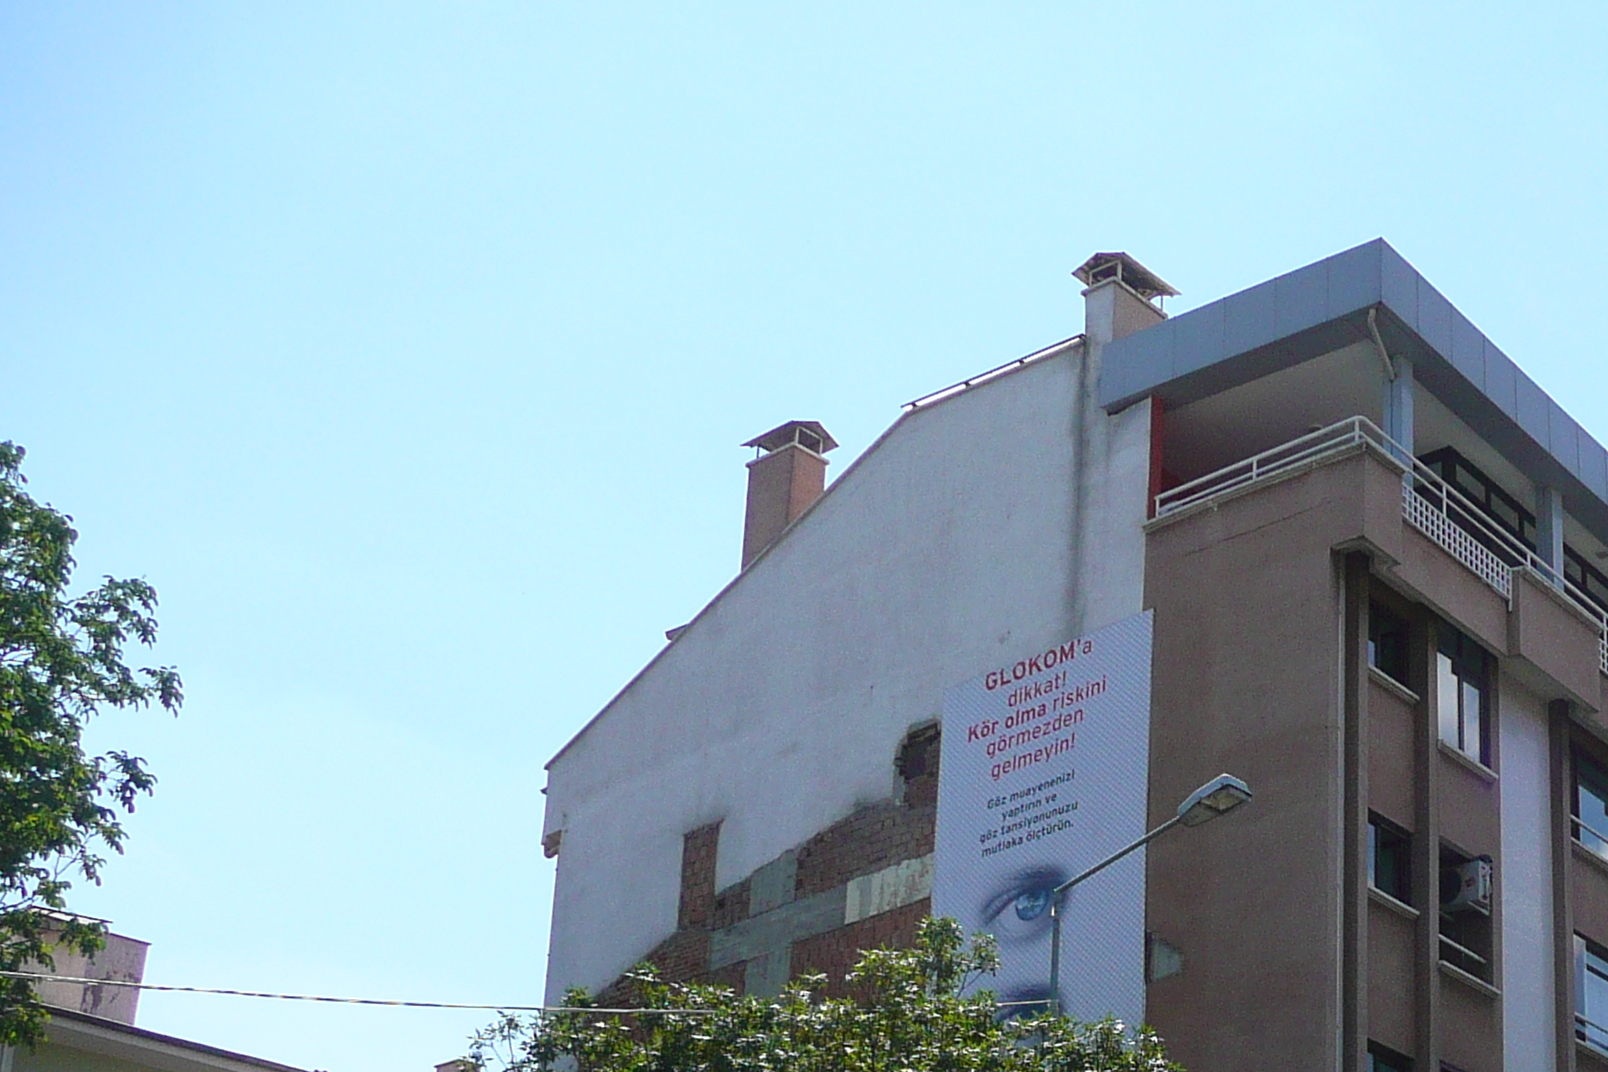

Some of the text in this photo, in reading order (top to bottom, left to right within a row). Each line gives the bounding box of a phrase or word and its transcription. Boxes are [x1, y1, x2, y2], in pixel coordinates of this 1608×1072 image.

[985, 638, 1093, 692] GLOKOM'a
[1008, 670, 1067, 707] dikkat!
[967, 674, 1107, 743] Kör olma riskini
[986, 708, 1084, 759] görmezden
[991, 732, 1075, 781] gelmeyin!
[987, 796, 1007, 809] Göz
[1045, 793, 1057, 804] ve
[980, 829, 998, 843] göz
[982, 836, 1024, 858] mutlaka
